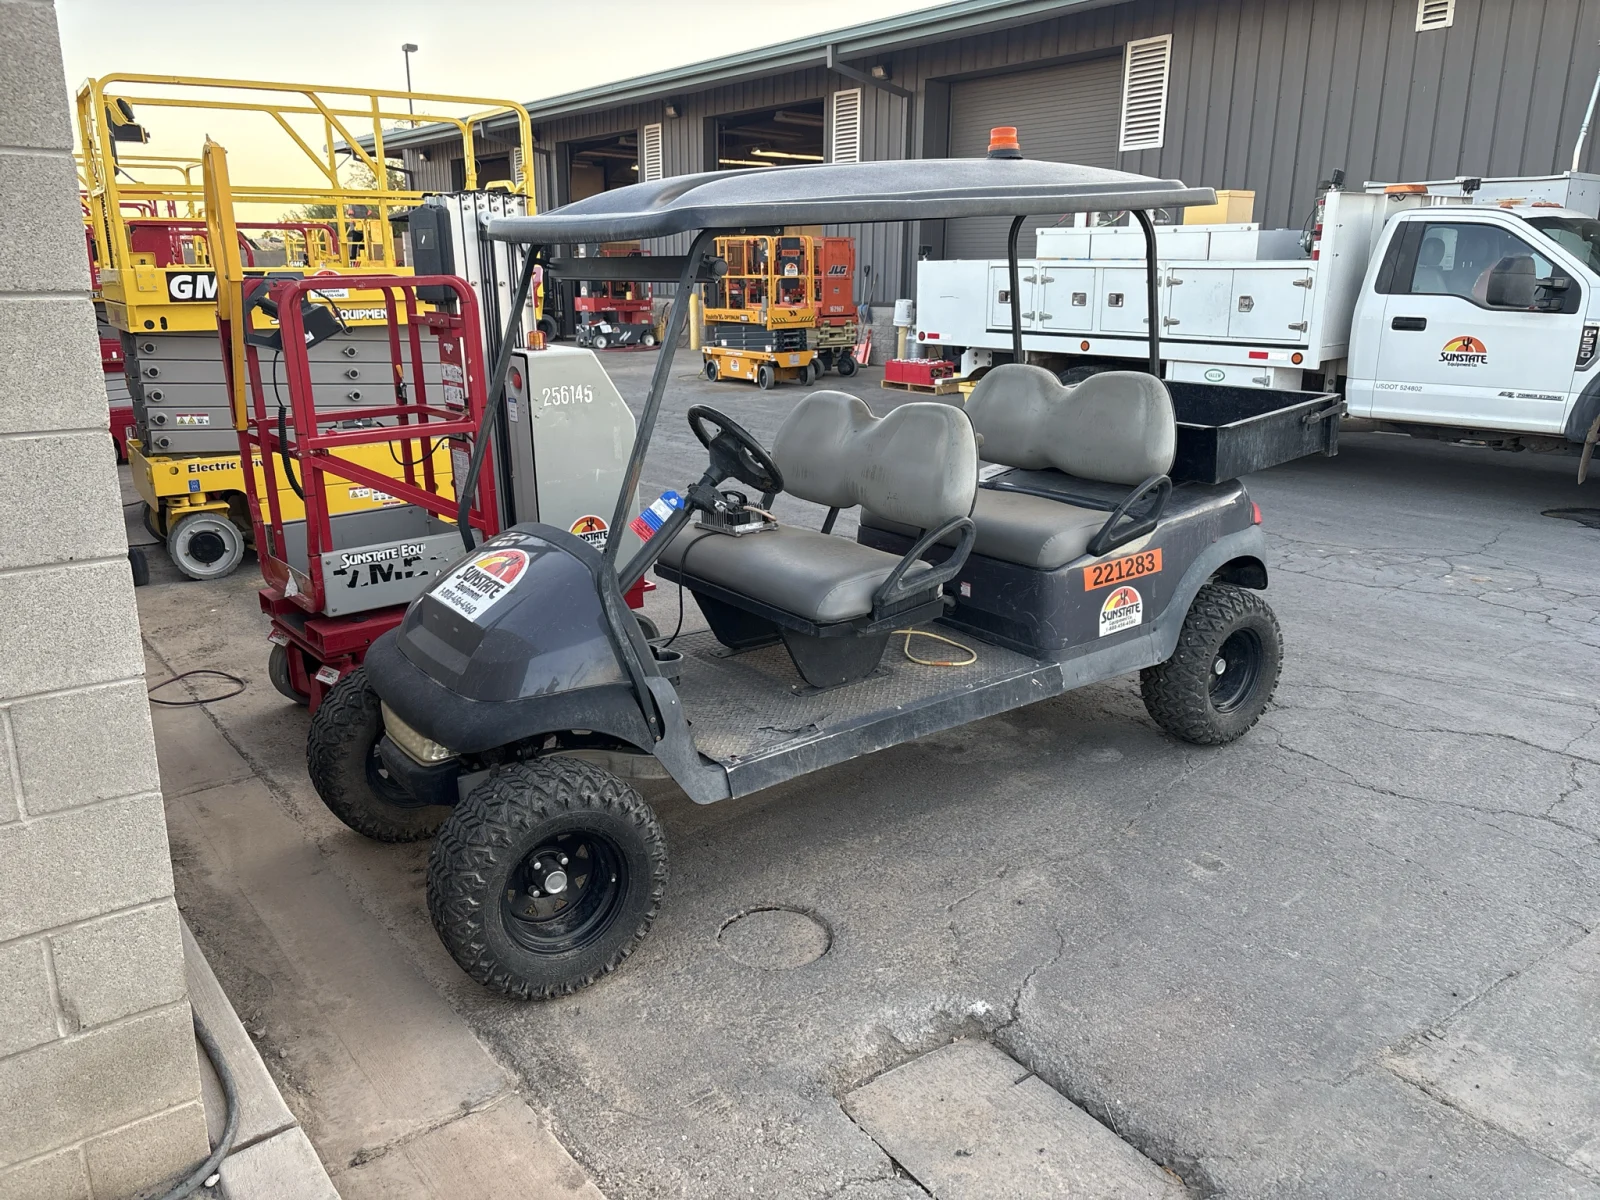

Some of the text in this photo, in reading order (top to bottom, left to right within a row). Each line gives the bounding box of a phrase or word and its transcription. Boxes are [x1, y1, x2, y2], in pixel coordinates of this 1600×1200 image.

[828, 265, 847, 275] JLG
[169, 274, 218, 299] GM
[333, 308, 387, 321] QUIPMEN
[1438, 352, 1488, 365] SUNSTATE
[541, 384, 594, 407] 256145
[1399, 384, 1423, 392] 524802
[187, 461, 237, 473] Electric
[577, 530, 608, 542] NSTATE
[340, 543, 427, 569] SUNSTATE EQU
[1092, 552, 1156, 587] 221283
[454, 580, 483, 602] Equipment
[455, 565, 505, 600] SUNSTATE
[1100, 603, 1142, 624] SUNSTATE
